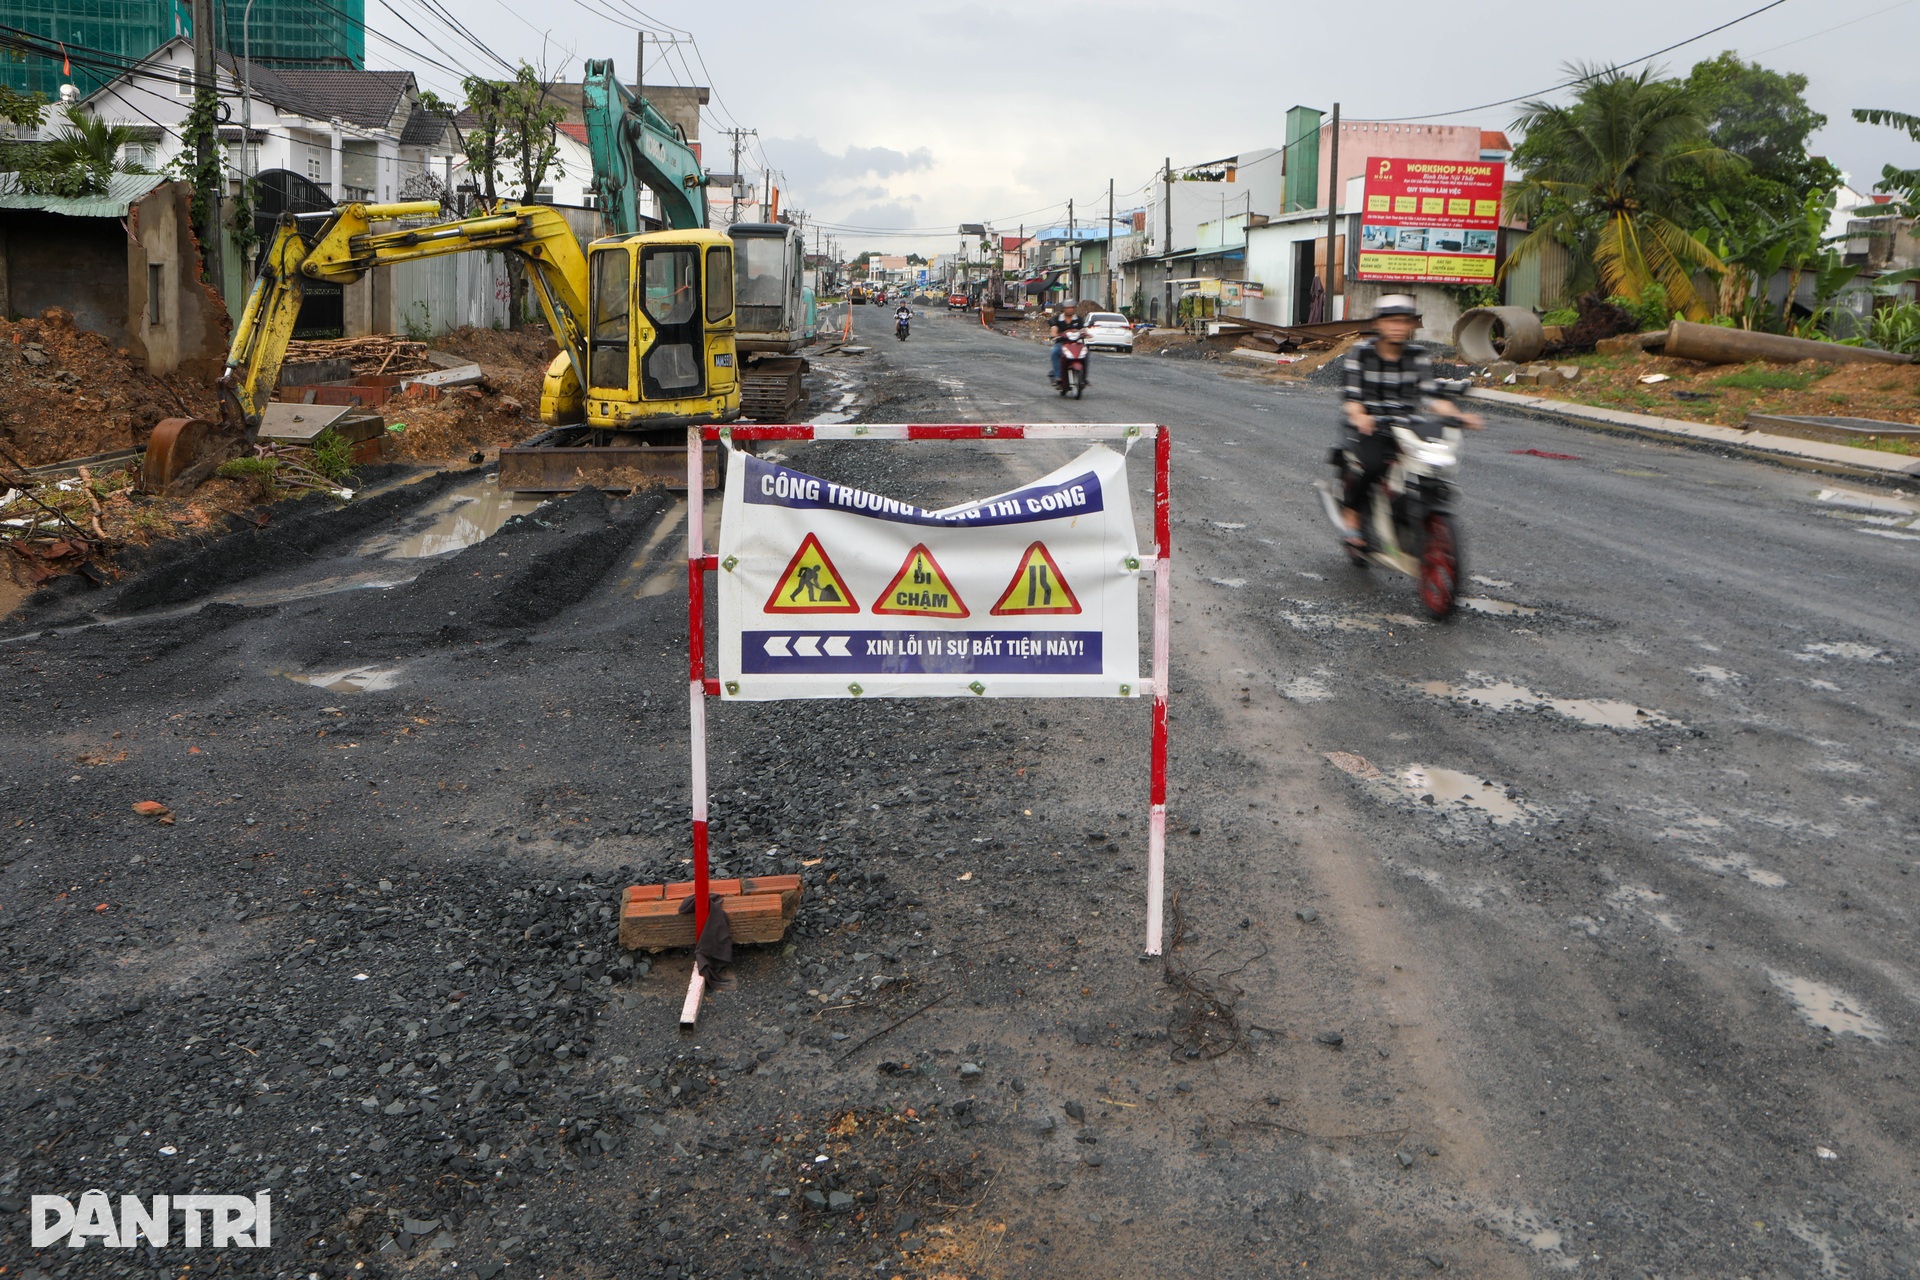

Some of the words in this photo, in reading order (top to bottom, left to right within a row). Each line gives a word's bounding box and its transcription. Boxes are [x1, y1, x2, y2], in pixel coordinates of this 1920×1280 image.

[1406, 163, 1456, 174] WORKSHOP
[1457, 165, 1492, 176] P-HOME
[761, 471, 821, 501] CÔNG
[985, 499, 1022, 518] THI
[896, 590, 948, 610] CHẬM
[866, 639, 894, 656] XIN
[898, 634, 923, 656] LỖI
[927, 636, 942, 656] VÌ
[946, 638, 970, 659] SỰ
[972, 634, 1003, 656] BẤT
[1006, 637, 1042, 659] TIỆN
[1046, 637, 1085, 656] NÀY!
